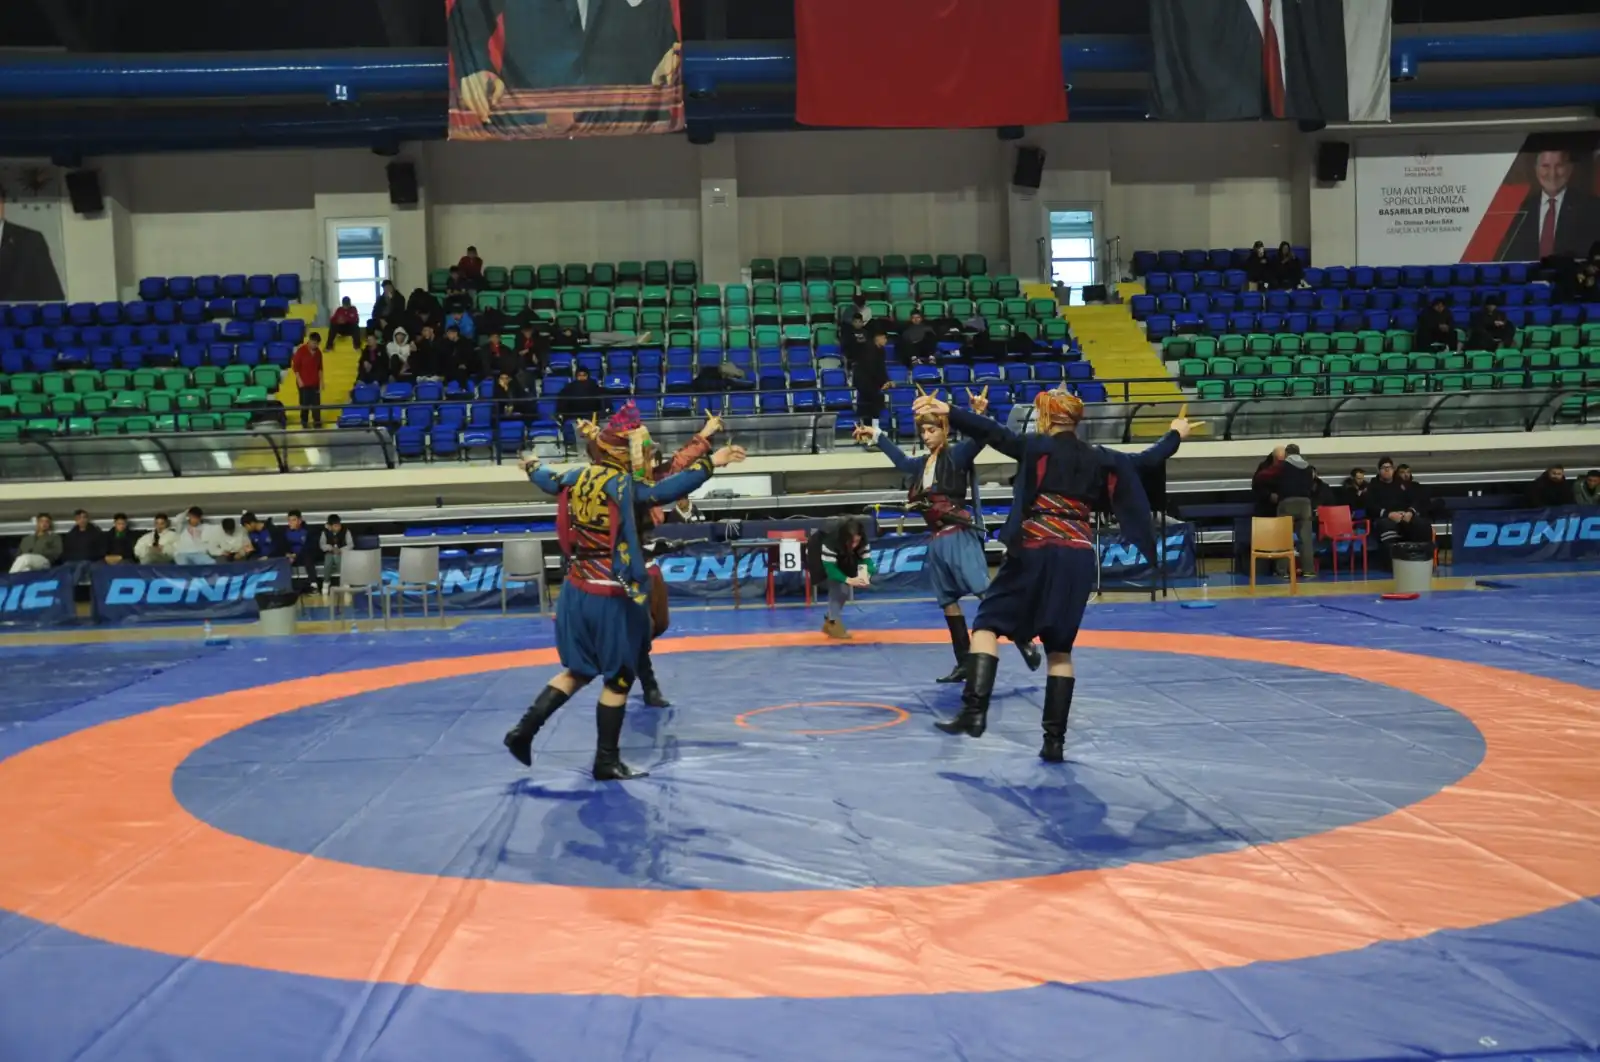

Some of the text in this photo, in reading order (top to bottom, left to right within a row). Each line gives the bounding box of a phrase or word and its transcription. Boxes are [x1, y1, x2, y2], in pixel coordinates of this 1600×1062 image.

[1455, 184, 1467, 194] VE
[1383, 195, 1465, 206] SPORCULARIMIZA
[784, 553, 796, 569] B
